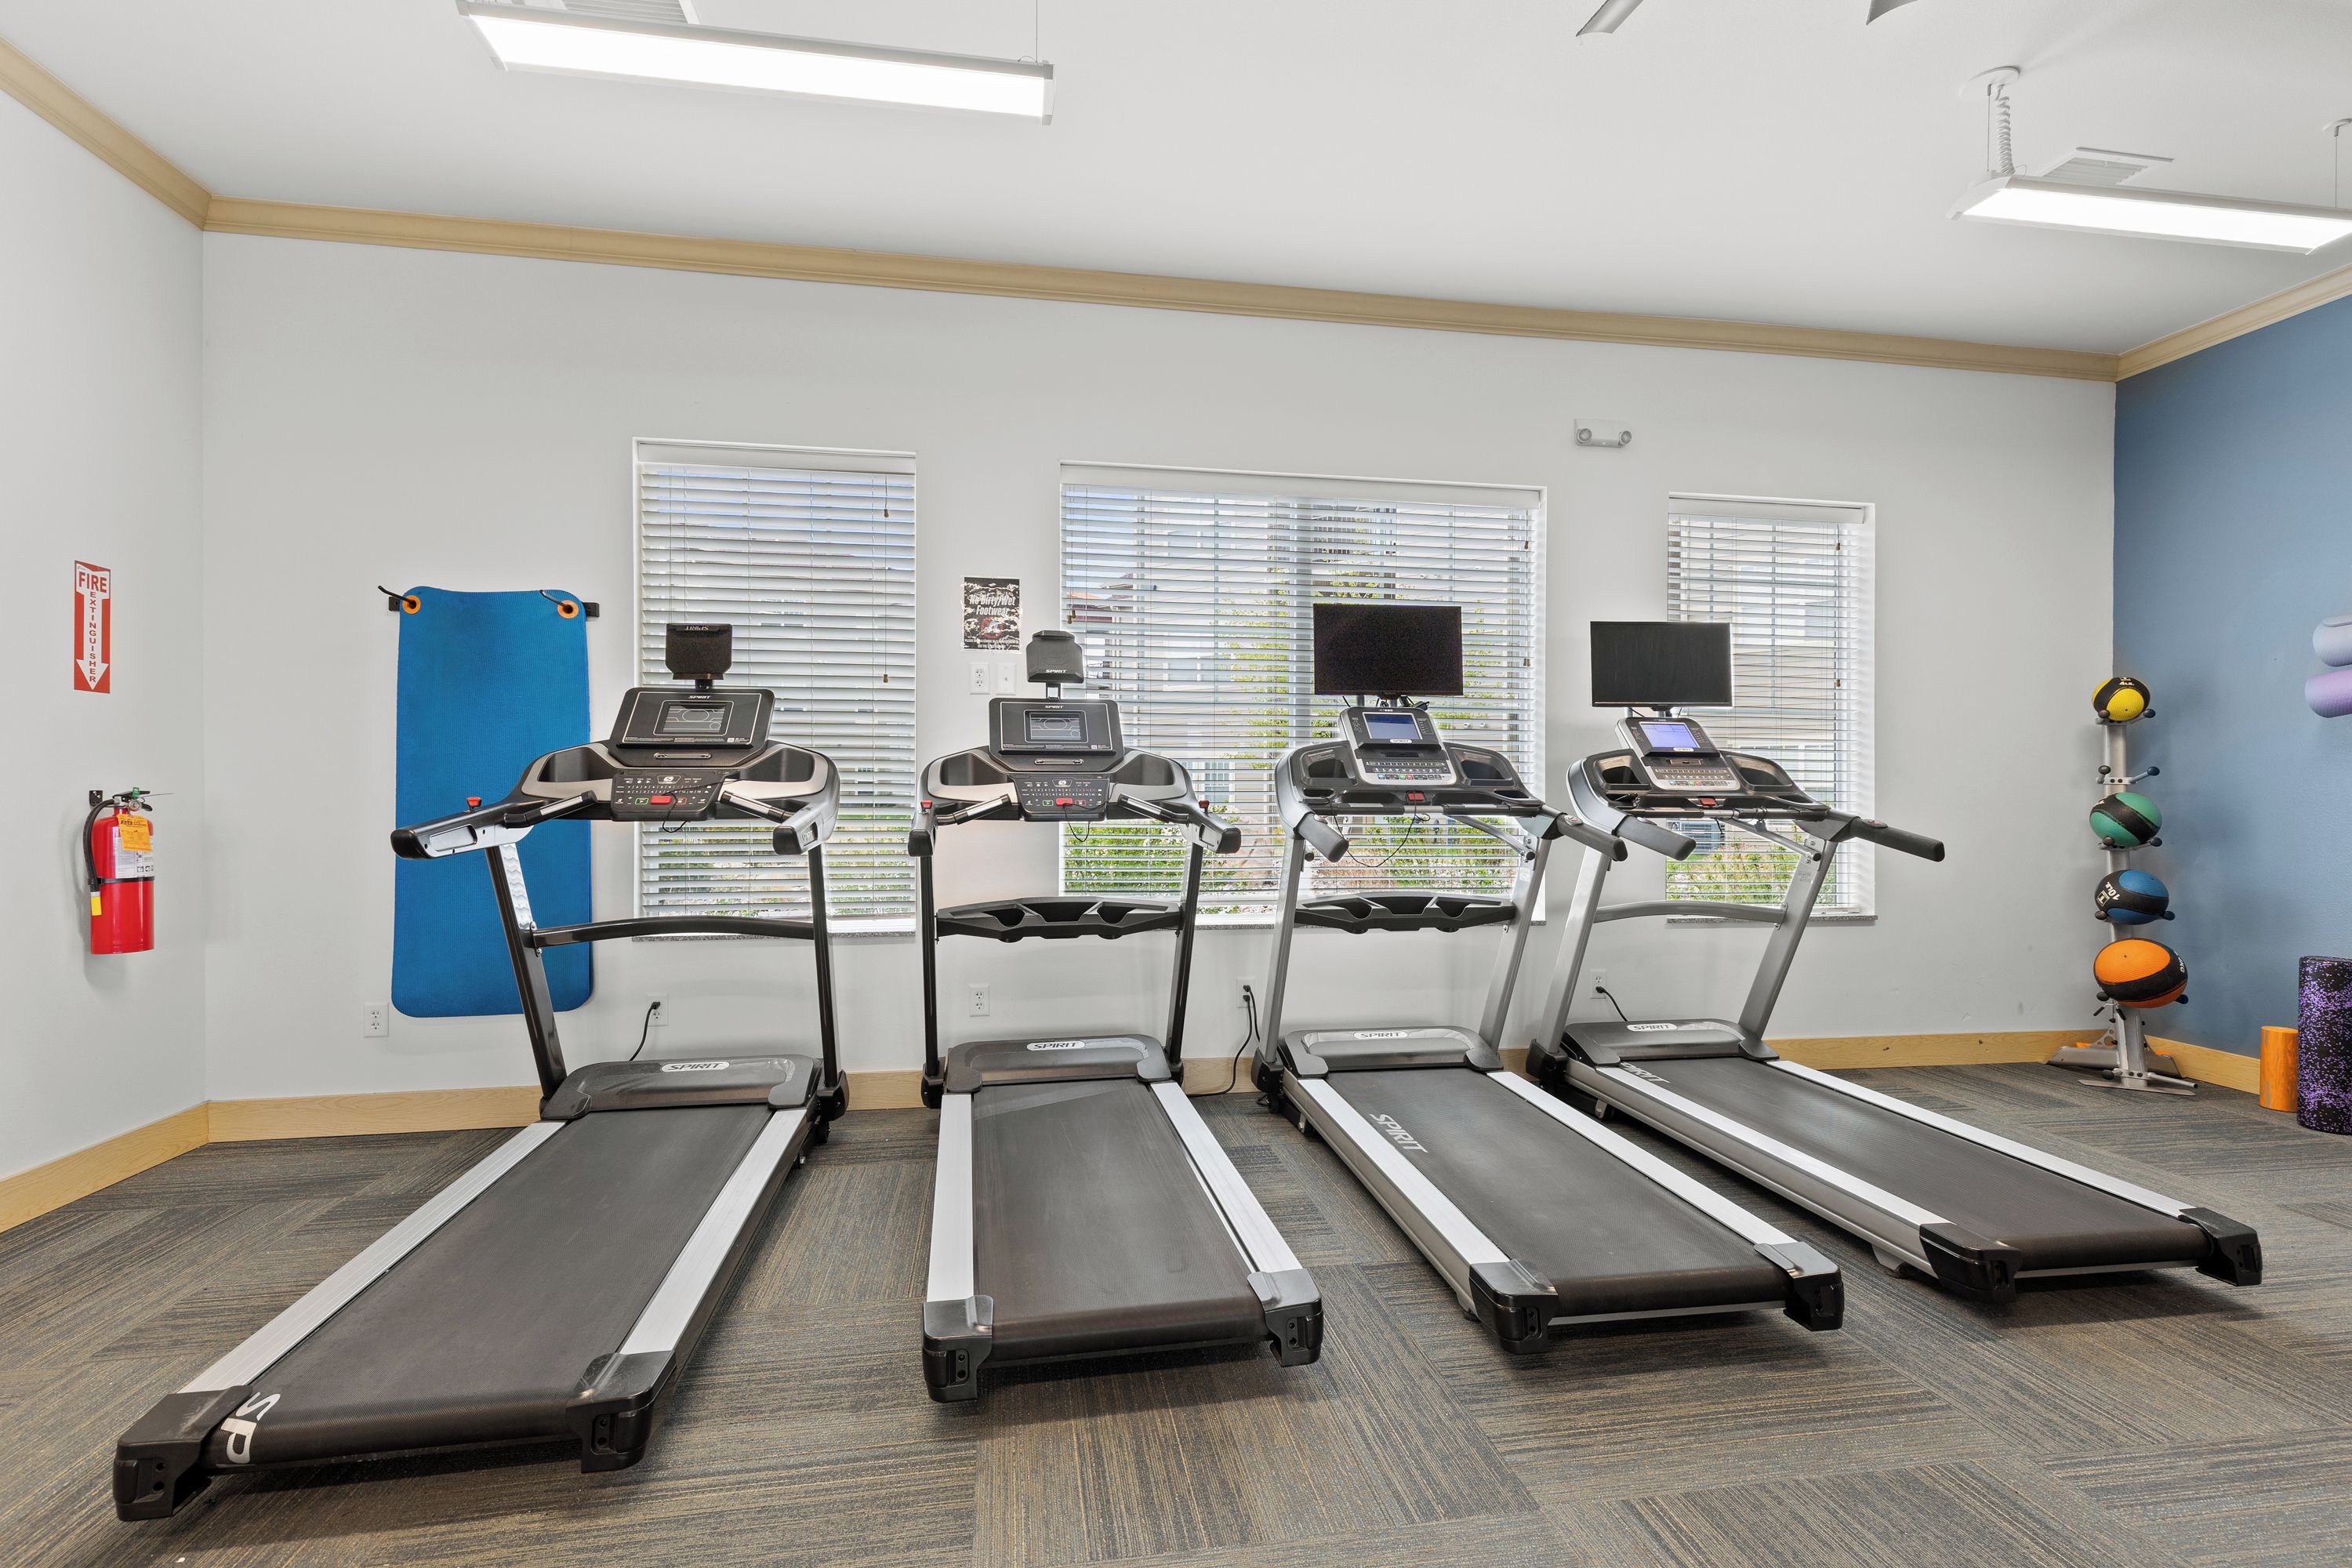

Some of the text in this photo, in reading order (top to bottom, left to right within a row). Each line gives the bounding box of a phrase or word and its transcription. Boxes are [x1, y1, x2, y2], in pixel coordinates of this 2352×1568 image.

[79, 572, 107, 593] FIRE
[969, 593, 1016, 607] No Dirty/Wet
[976, 605, 1009, 616] Footwear
[667, 1062, 723, 1071] SPIRIT
[1369, 1113, 1429, 1153] SPIRIT
